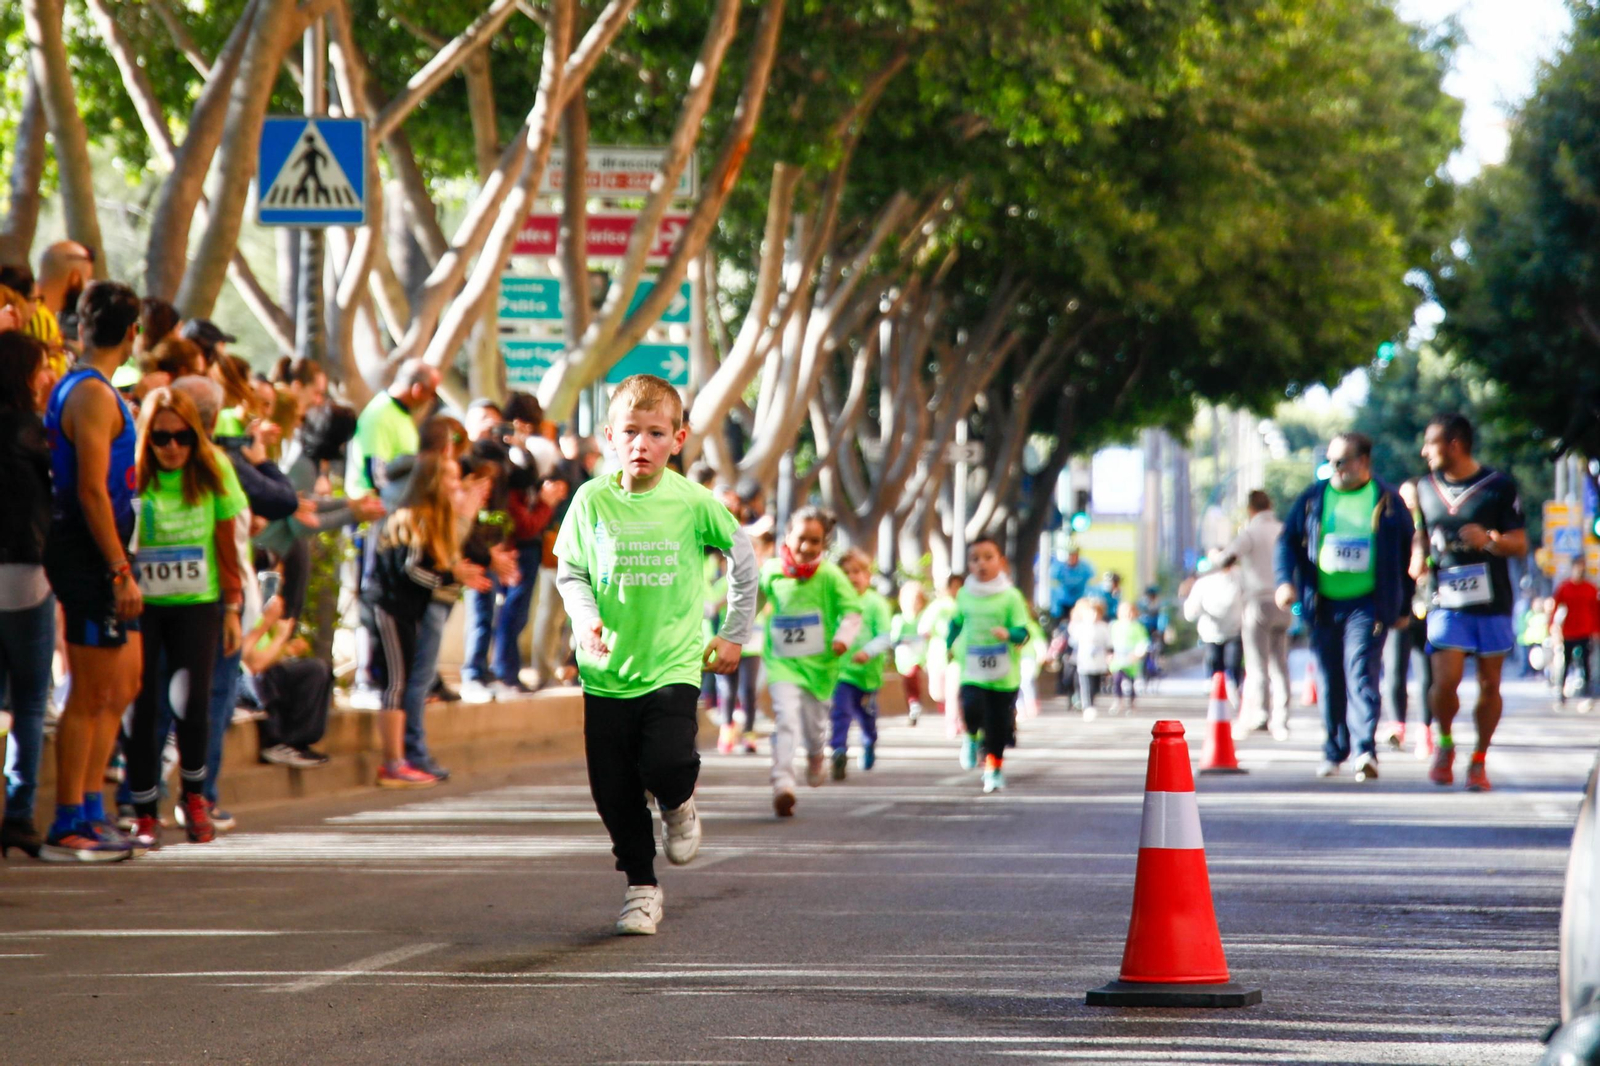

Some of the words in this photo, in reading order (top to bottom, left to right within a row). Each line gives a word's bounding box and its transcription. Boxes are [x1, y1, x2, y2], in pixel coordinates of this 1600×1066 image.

[629, 538, 680, 551] marcha
[664, 551, 679, 567] el
[142, 562, 200, 580] 1015
[613, 568, 678, 587] cáncer
[783, 628, 806, 644] 22
